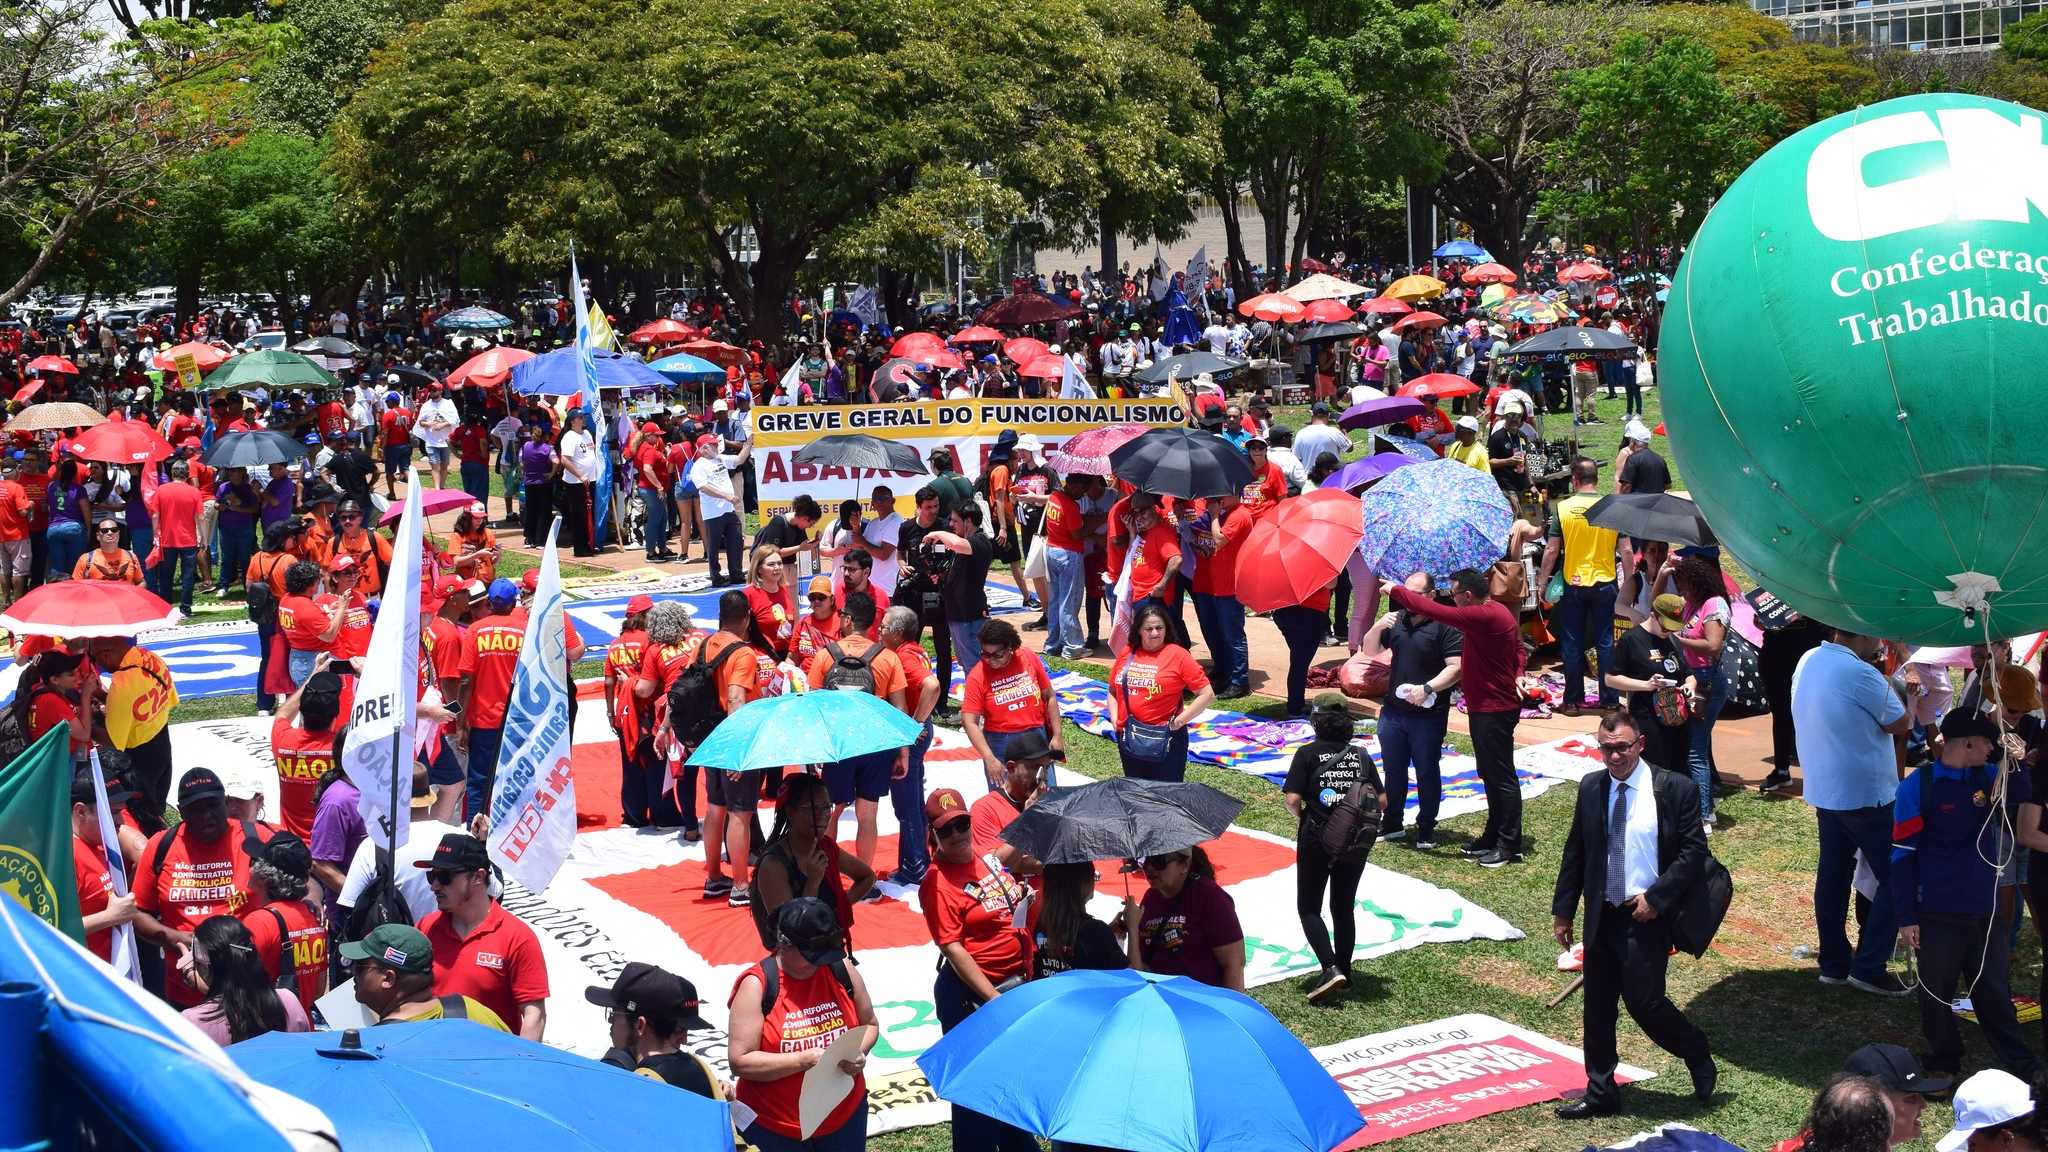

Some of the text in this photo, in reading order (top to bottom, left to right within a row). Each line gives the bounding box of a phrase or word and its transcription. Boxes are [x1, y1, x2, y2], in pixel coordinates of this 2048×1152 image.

[758, 404, 1184, 433] GREVE GERAL DO FUNCIONALISMO
[761, 443, 926, 485] ABA
[171, 870, 234, 879] ADMINISTRATIVA
[197, 861, 233, 871] REFORMA
[181, 877, 232, 888] DEMOLIÇÃO
[170, 887, 232, 901] CANCELA
[792, 1018, 844, 1038] DEMOLIÇÃO
[1337, 1044, 1526, 1092] REFORMA
